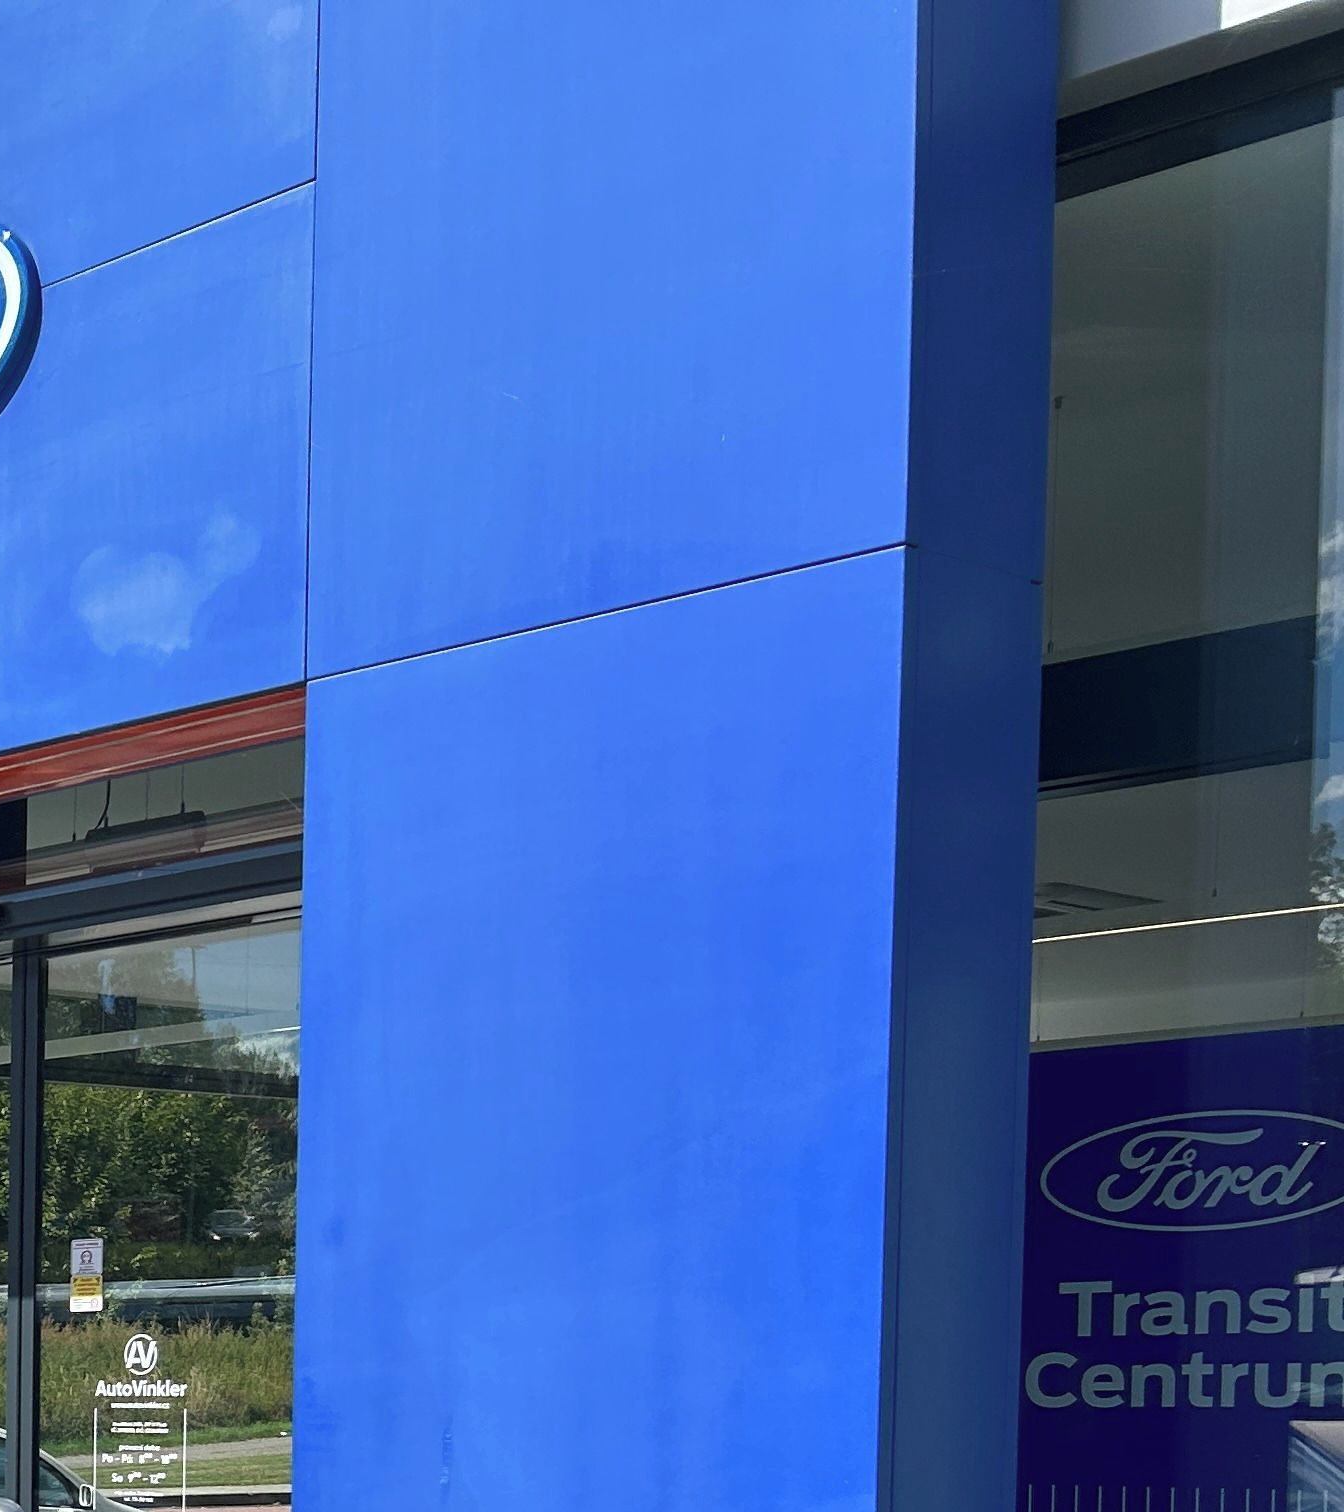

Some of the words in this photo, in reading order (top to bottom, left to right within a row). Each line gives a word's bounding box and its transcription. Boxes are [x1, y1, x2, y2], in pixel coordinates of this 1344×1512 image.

[1097, 1127, 1323, 1212] Ford
[1058, 1279, 1344, 1337] Transit
[94, 1379, 188, 1397] AutoVinkler
